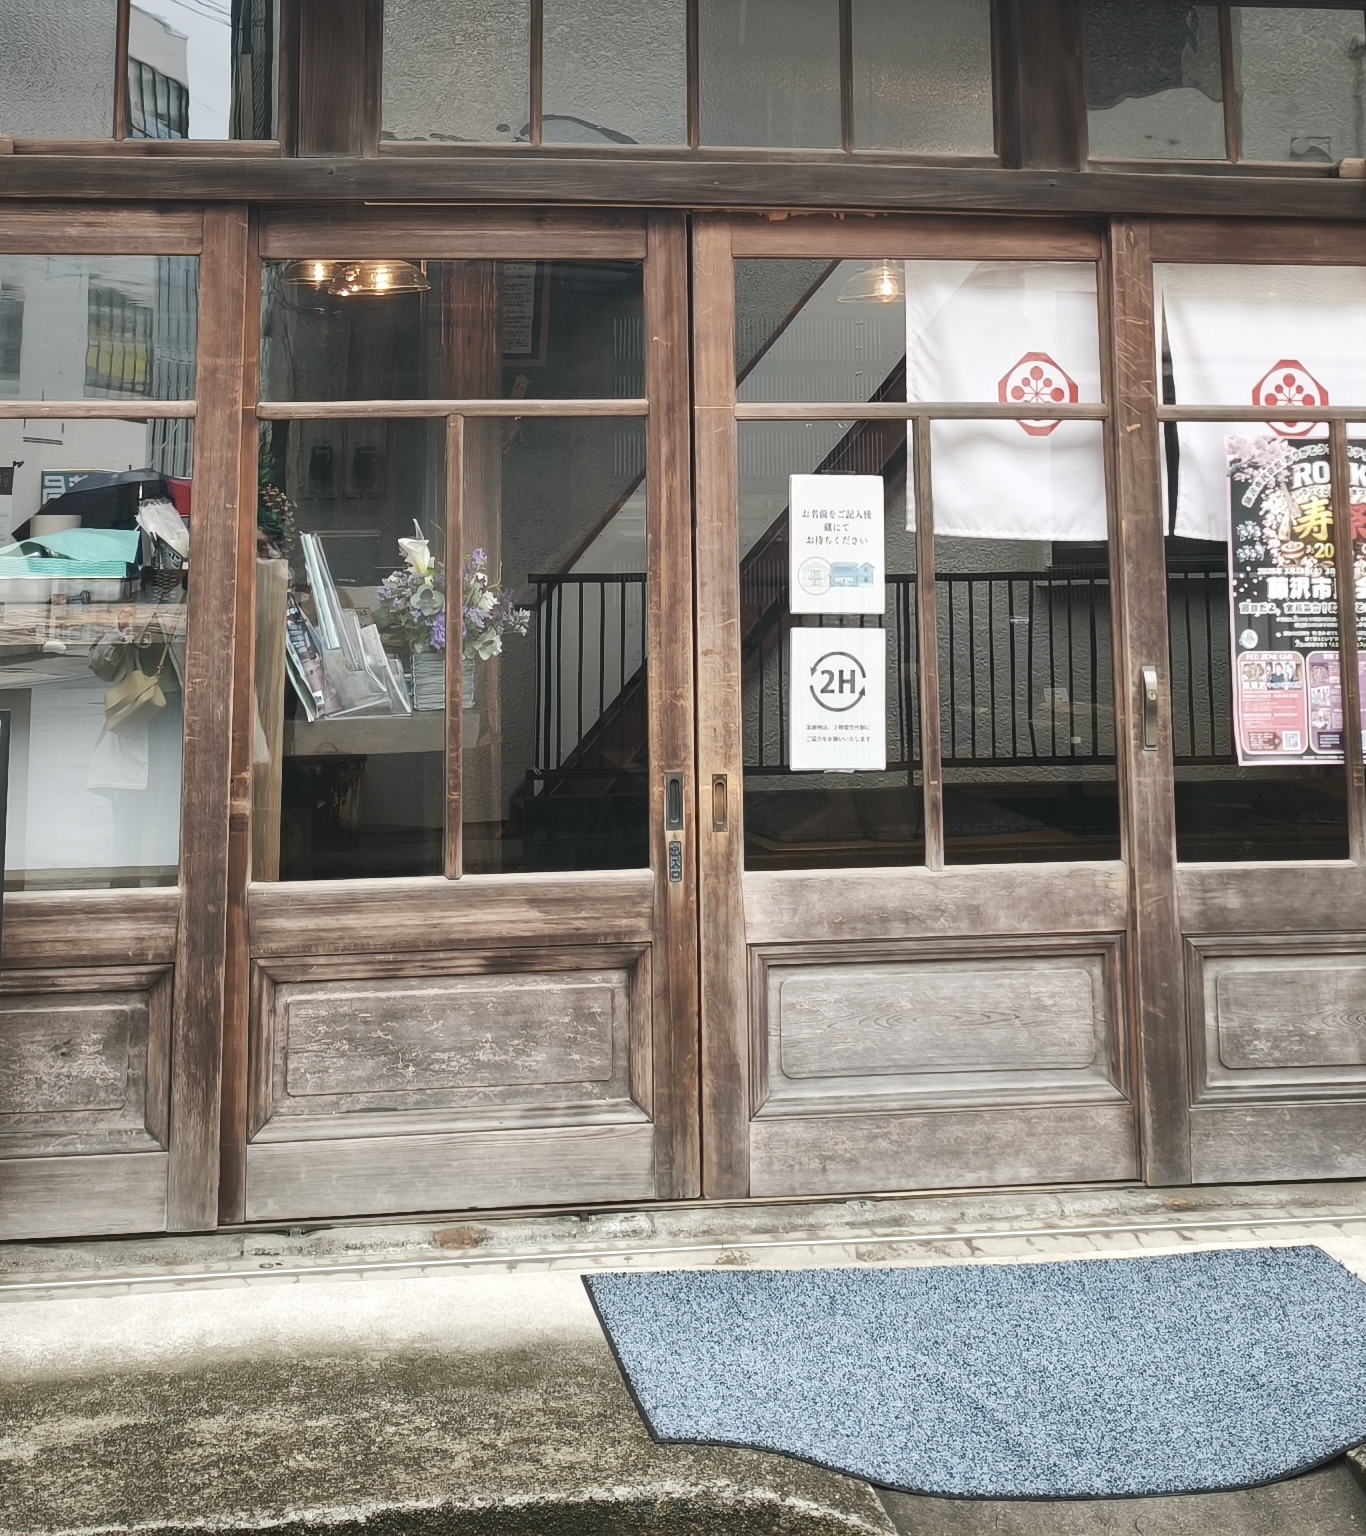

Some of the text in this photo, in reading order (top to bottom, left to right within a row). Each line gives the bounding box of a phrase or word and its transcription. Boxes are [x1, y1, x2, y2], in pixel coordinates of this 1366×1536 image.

[801, 509, 873, 520] お名前をご記入後
[805, 535, 869, 546] お待ちください
[820, 669, 856, 694] 2H
